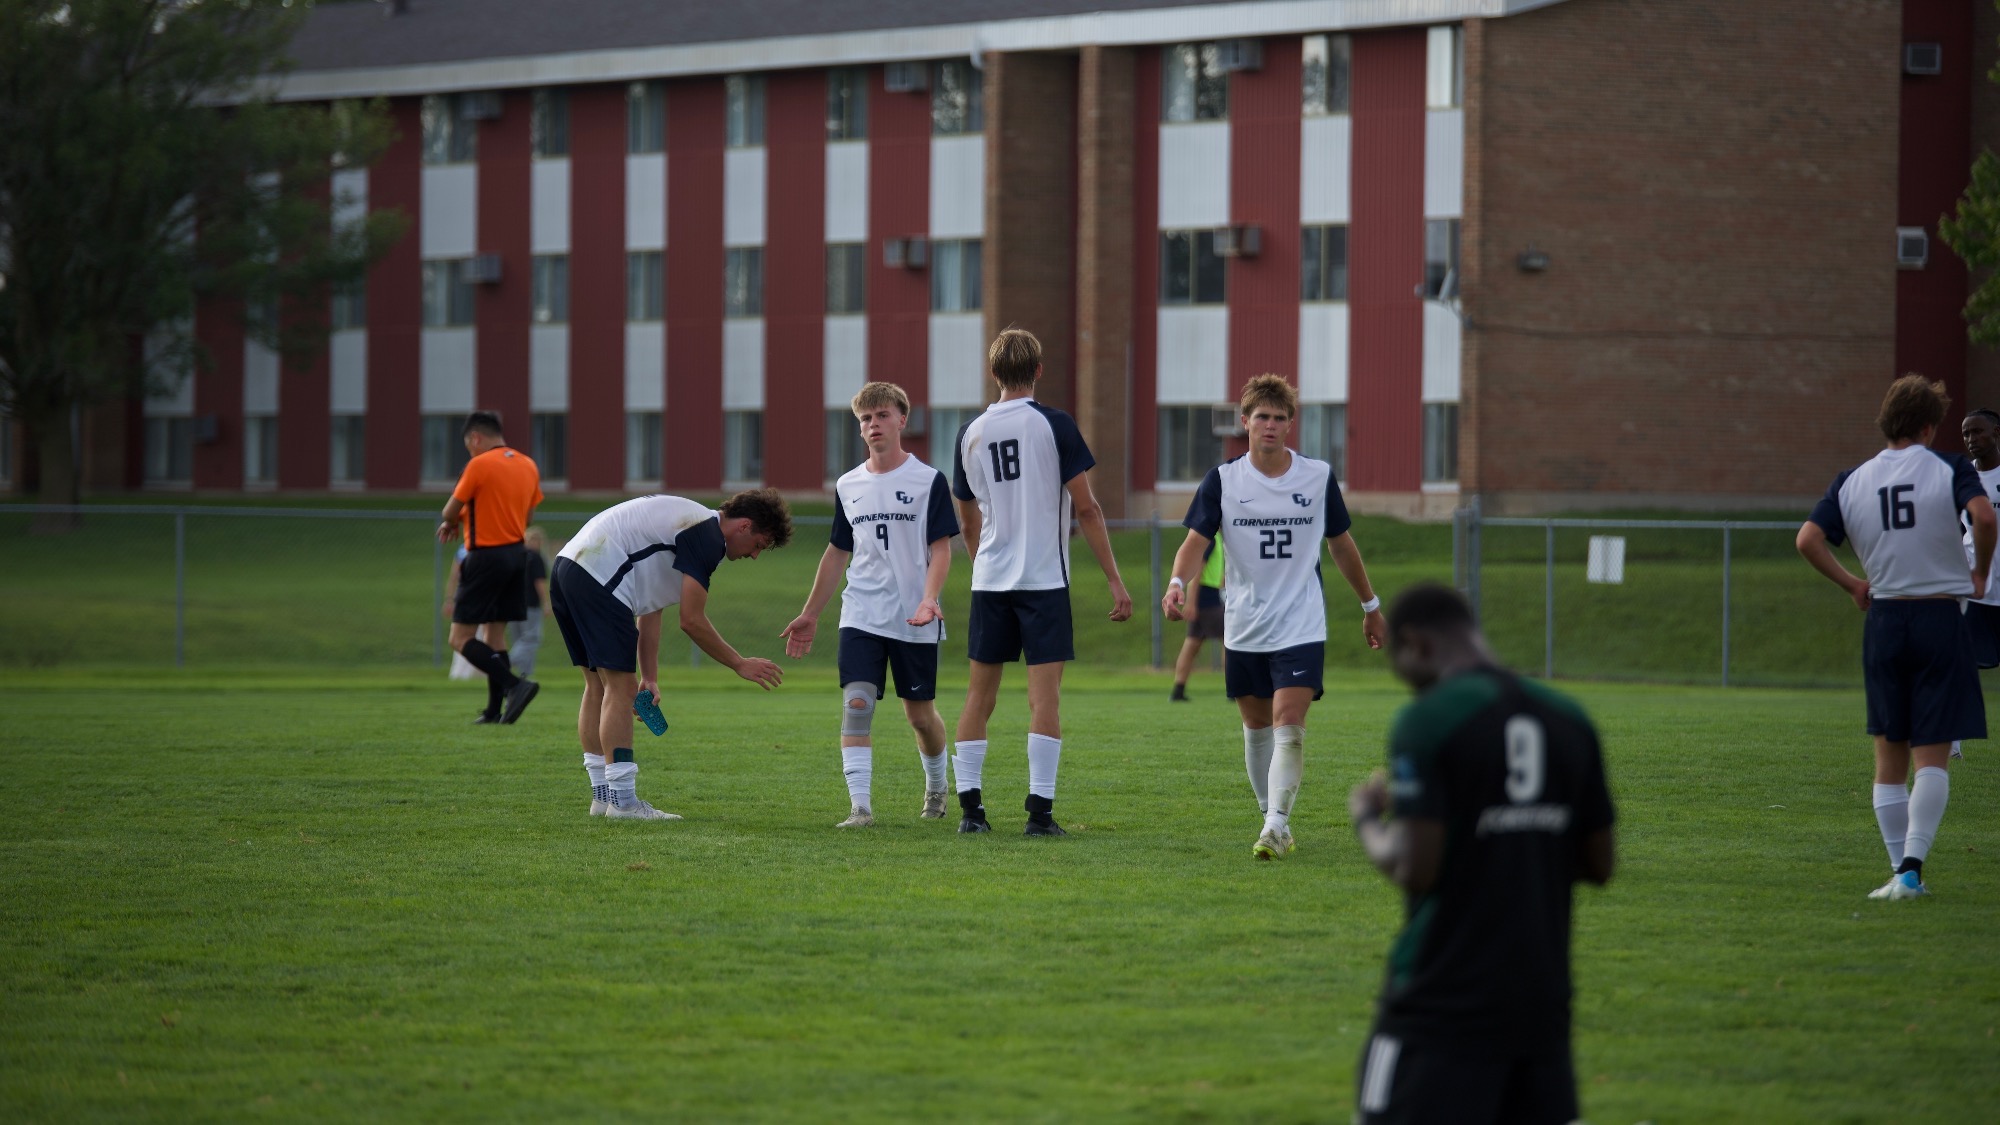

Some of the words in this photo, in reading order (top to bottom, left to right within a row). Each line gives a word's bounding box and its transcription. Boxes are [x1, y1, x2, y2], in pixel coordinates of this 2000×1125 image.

[988, 439, 1021, 483] 18
[1232, 516, 1314, 527] CORNERSTONE
[1877, 483, 1916, 532] 16
[875, 523, 889, 551] 9
[1259, 529, 1293, 560] 22
[1503, 713, 1547, 804] 9
